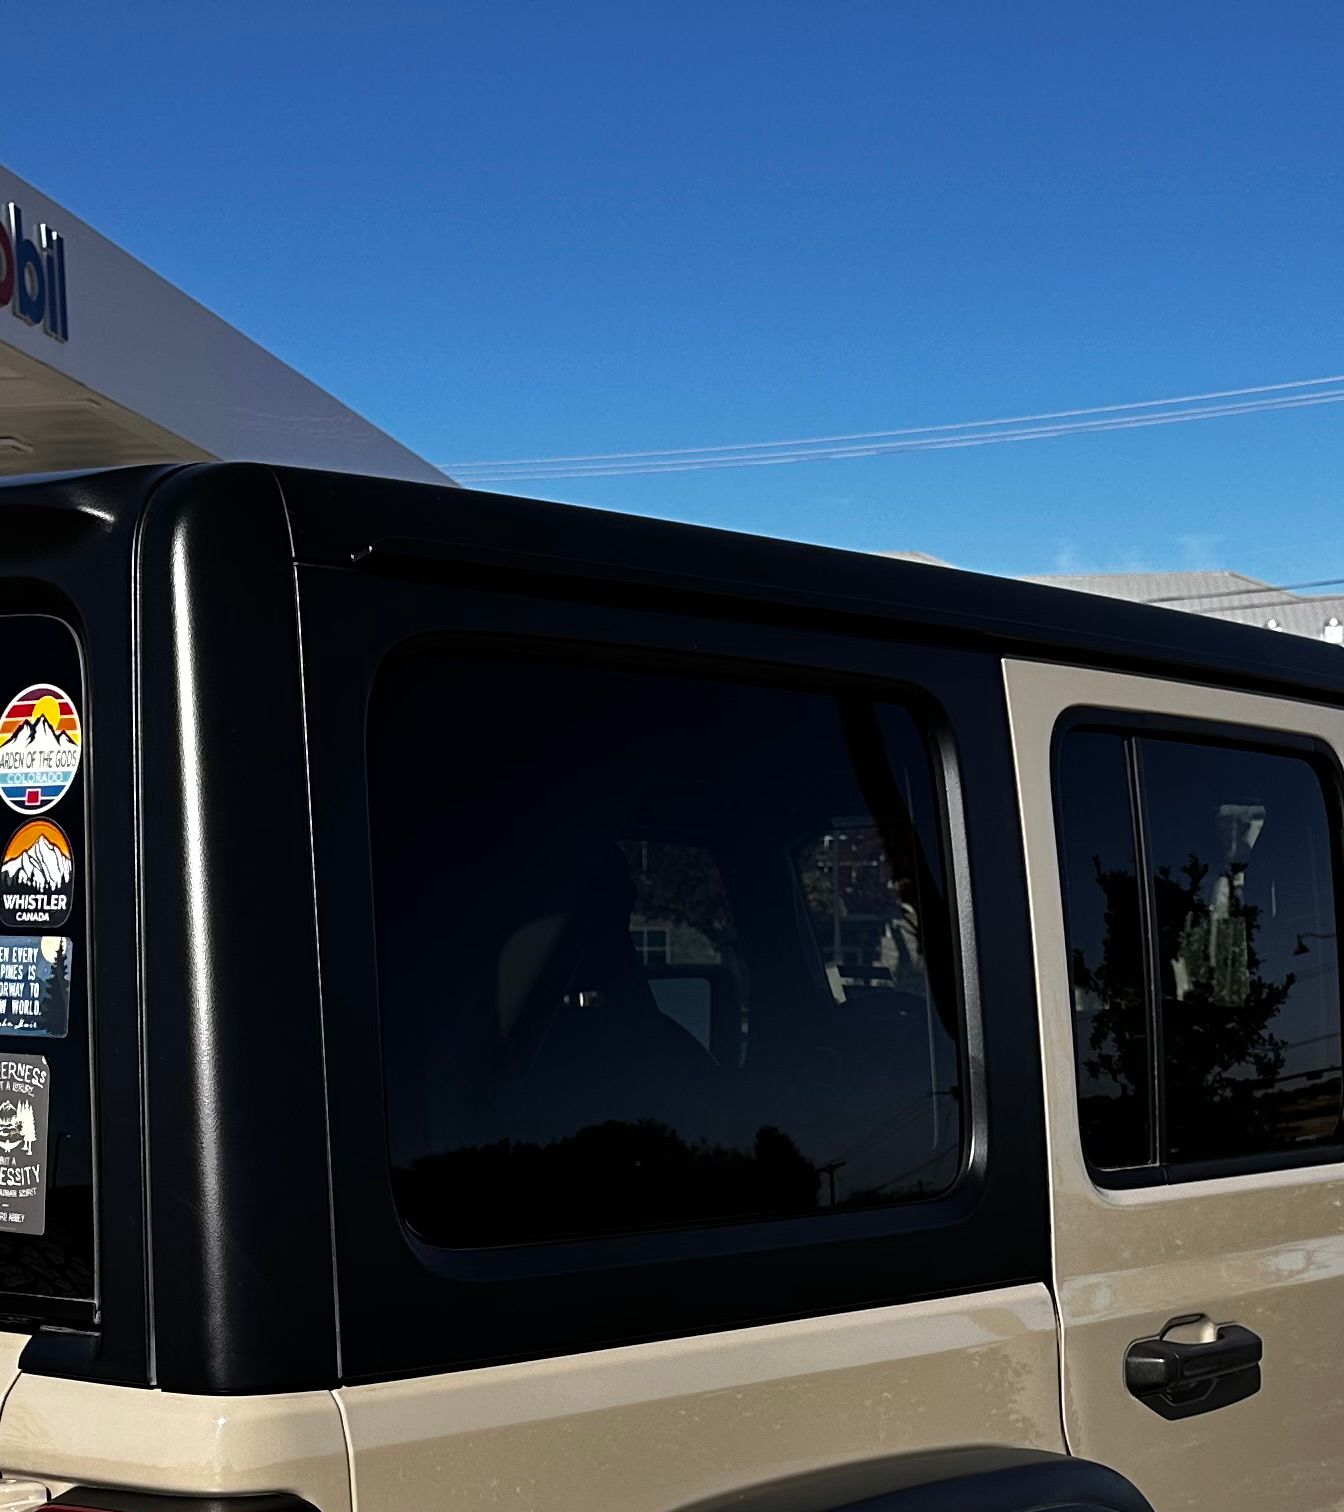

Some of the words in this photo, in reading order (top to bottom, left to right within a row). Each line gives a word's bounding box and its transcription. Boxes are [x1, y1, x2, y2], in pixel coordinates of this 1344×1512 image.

[25, 751, 36, 769] OF
[38, 751, 53, 769] THE
[56, 750, 77, 768] GODS
[7, 772, 63, 784] COLORADO
[3, 894, 67, 910] WHISTLER
[15, 911, 50, 922] CANADA
[12, 946, 39, 963] EVERY
[0, 964, 24, 980] PINES
[27, 964, 37, 980] IS
[29, 982, 40, 998] TO
[5, 1080, 11, 1091] A
[0, 1155, 10, 1166] BUT
[12, 1156, 17, 1166] A
